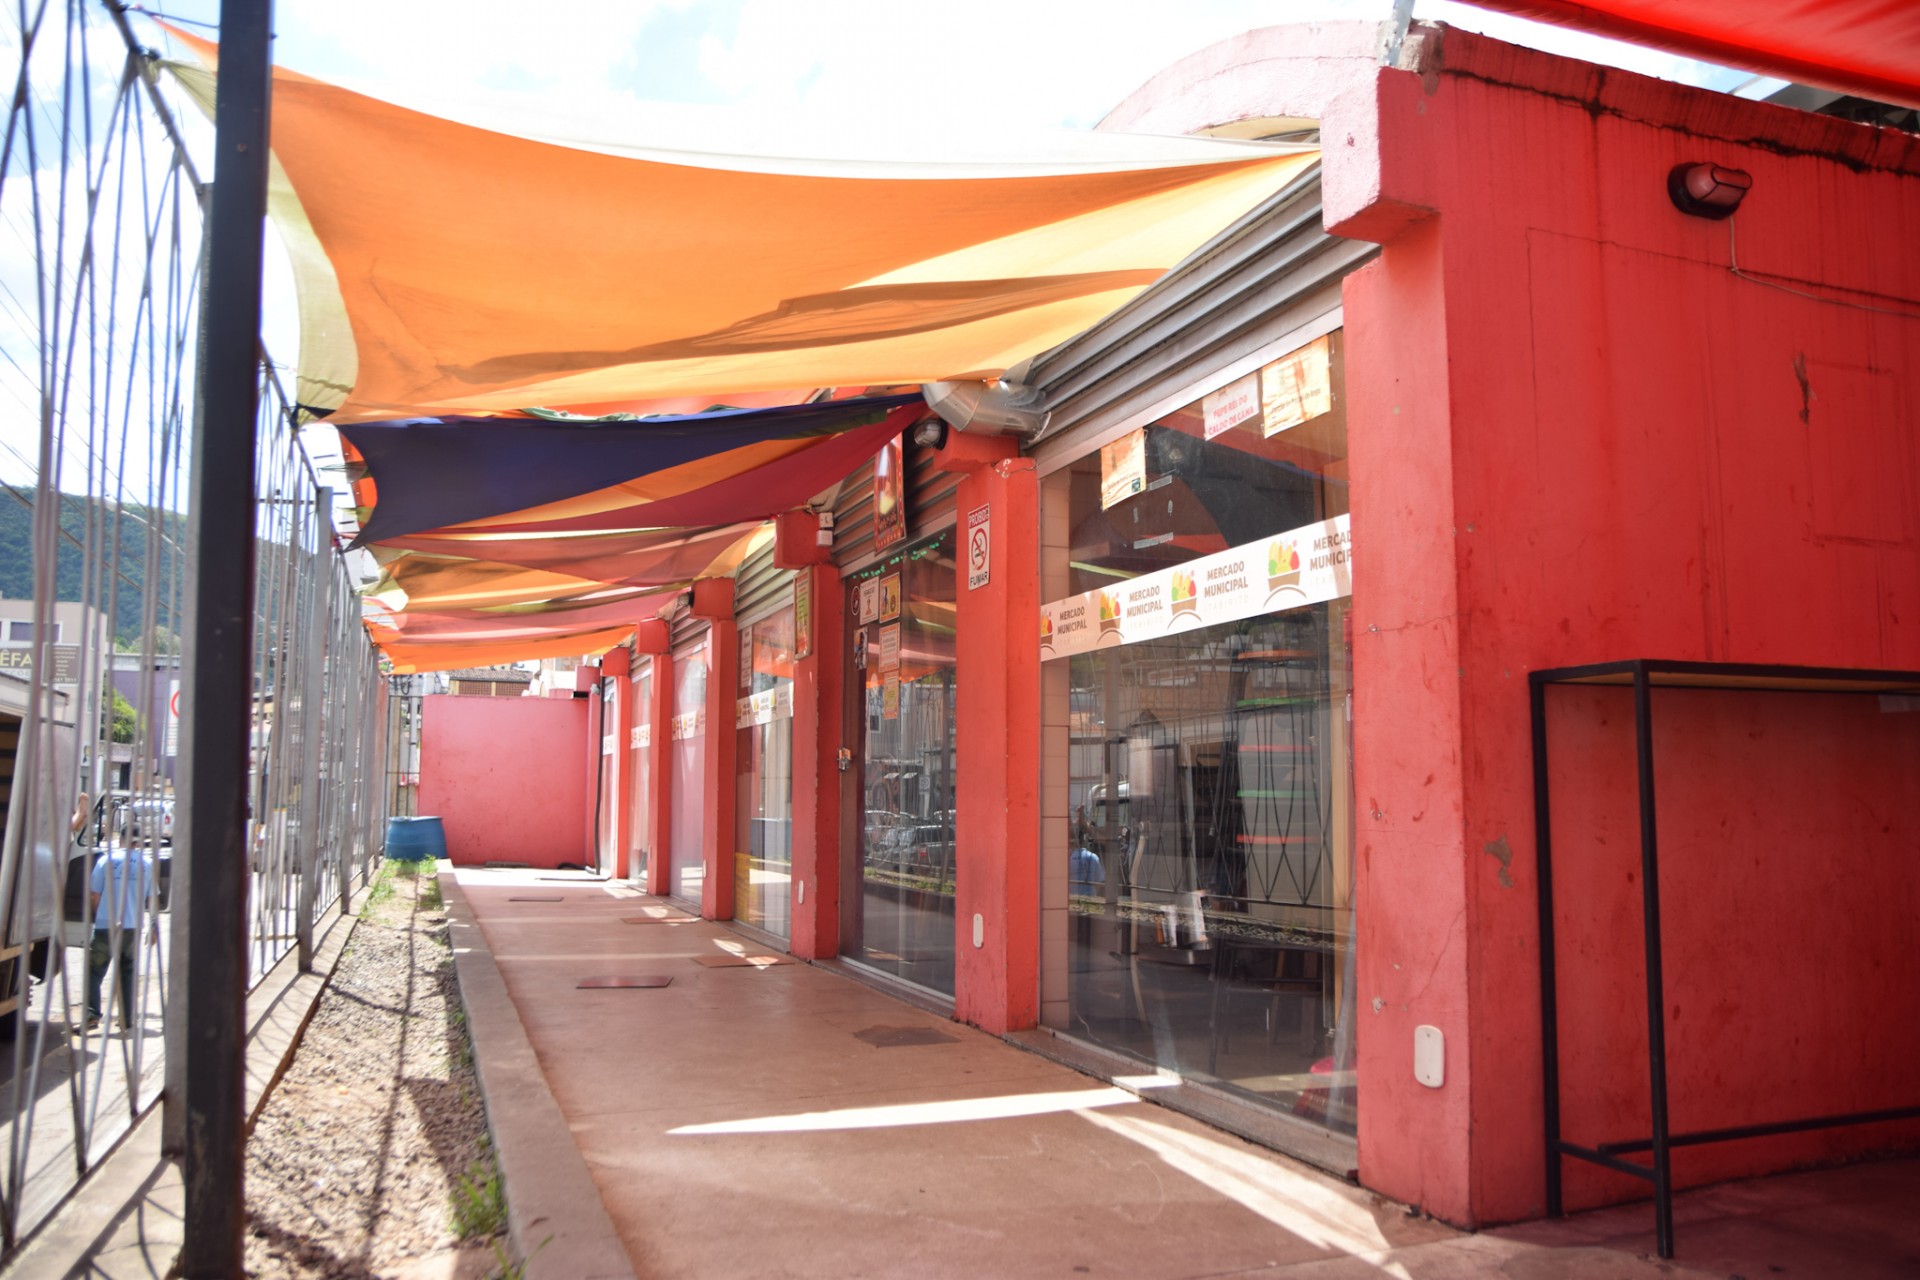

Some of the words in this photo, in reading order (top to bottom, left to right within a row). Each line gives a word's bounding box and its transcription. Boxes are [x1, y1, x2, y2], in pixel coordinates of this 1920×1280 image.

[1208, 419, 1228, 435] CALDO
[1229, 414, 1237, 425] DE
[1313, 530, 1351, 551] MERCAD
[1310, 548, 1352, 571] MUNICIP
[970, 571, 988, 587] FUMAR
[1207, 560, 1245, 581] MERCADO
[1129, 585, 1160, 602] MERCADO
[1204, 576, 1249, 598] MUNICIPAL
[1059, 606, 1085, 621] MERCADO
[1127, 600, 1163, 618] MUNICIPAL
[1057, 620, 1087, 635] MUNICIPAL
